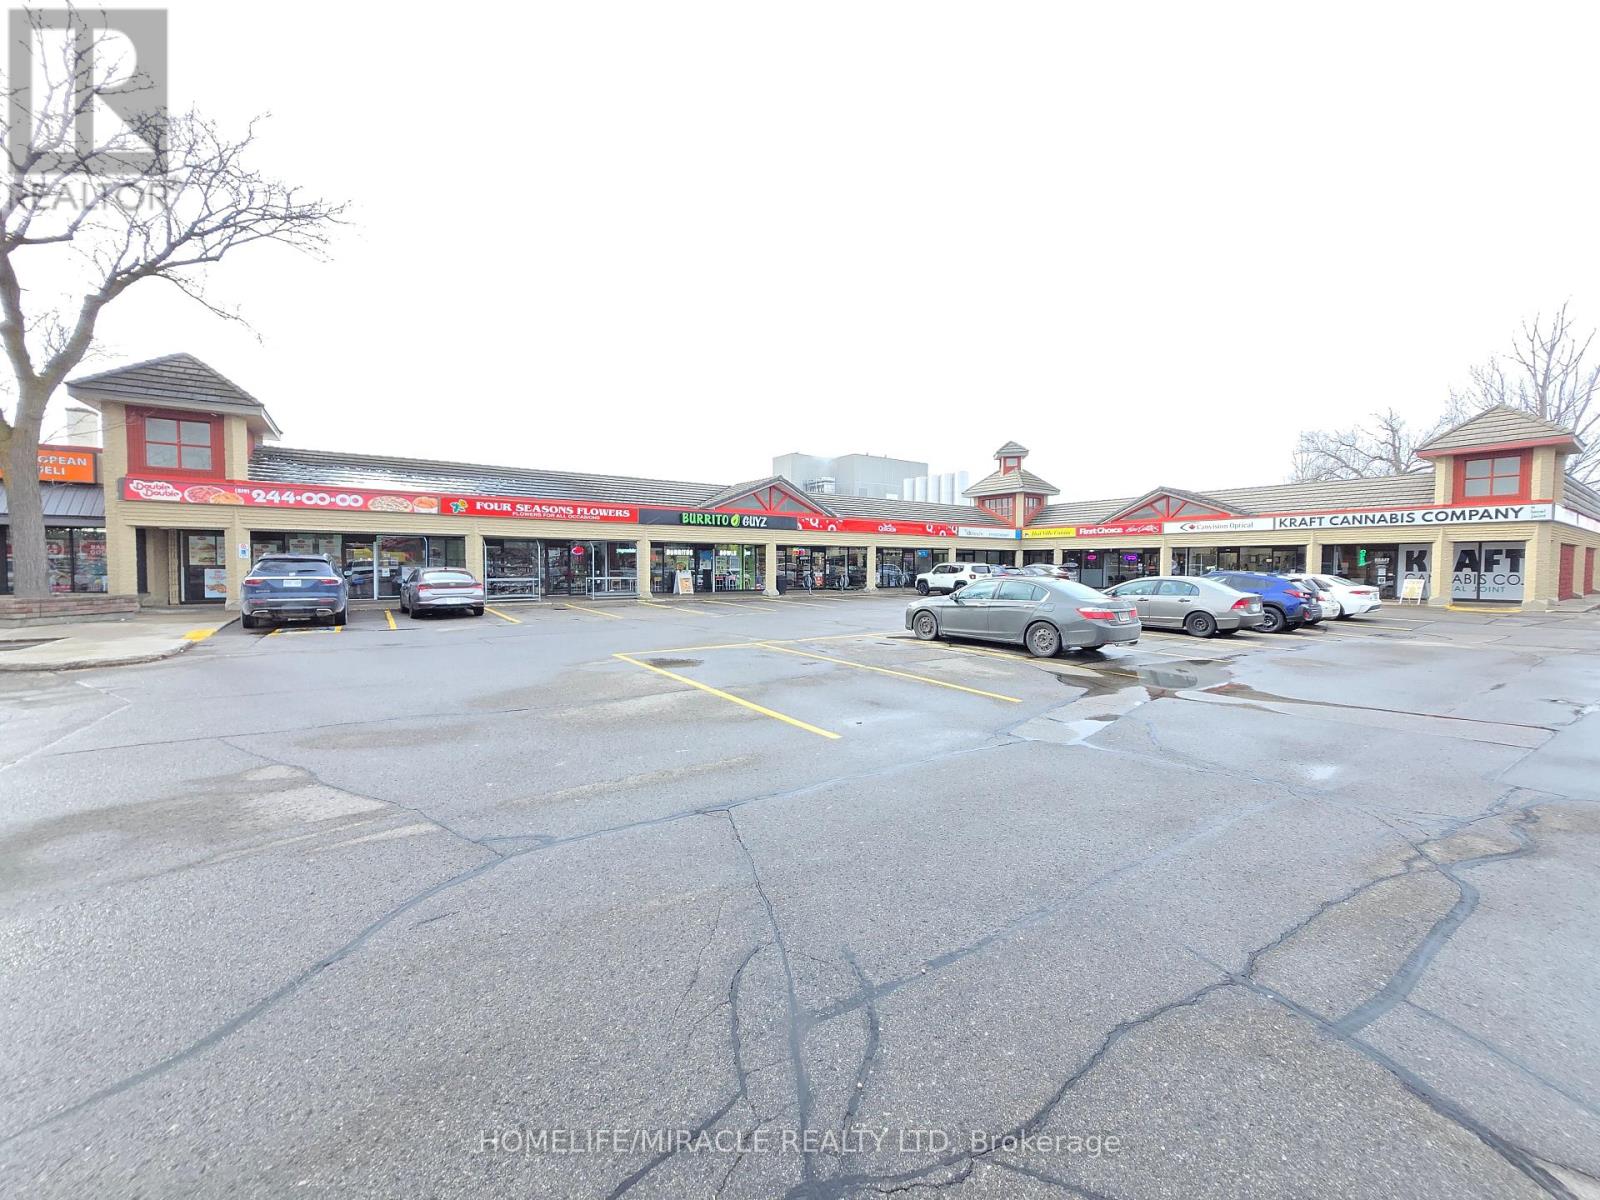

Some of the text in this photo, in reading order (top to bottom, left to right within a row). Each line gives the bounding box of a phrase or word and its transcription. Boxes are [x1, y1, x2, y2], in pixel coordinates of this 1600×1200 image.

[38, 455, 87, 466] OPEAN
[132, 481, 170, 491] Double
[142, 489, 180, 497] Double
[475, 501, 631, 518] FOUR SEASONS FLOWERS
[682, 512, 767, 528] BURRITO GUYZ
[1278, 516, 1325, 529] KRAFT
[1329, 511, 1415, 526] CANNABIS
[1421, 507, 1524, 523] COMPANY
[1406, 549, 1526, 573] KAFT
[1493, 573, 1525, 586] CO.
